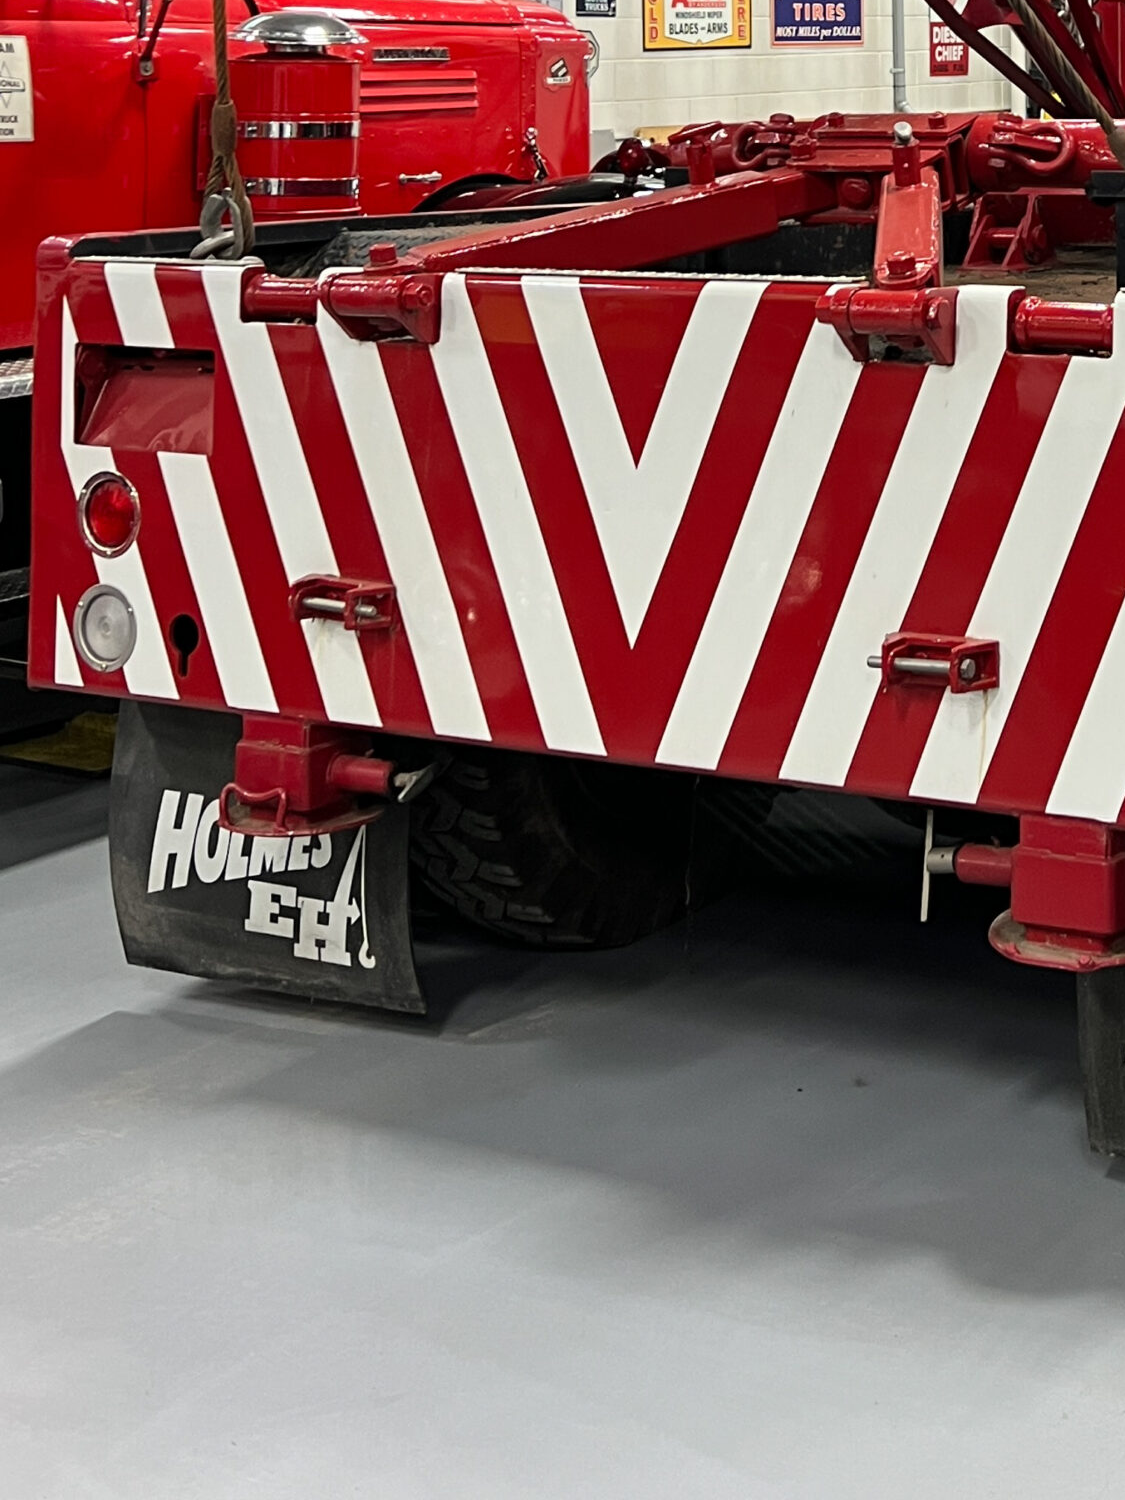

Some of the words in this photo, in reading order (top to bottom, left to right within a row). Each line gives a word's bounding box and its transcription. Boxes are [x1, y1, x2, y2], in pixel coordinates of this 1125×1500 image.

[584, 2, 609, 11] TRUCKS
[792, 2, 846, 21] TIRES
[675, 11, 706, 19] WINDSHIELD
[669, 22, 699, 35] BLADES
[707, 22, 728, 34] ARMS
[776, 26, 797, 37] MOST
[797, 26, 820, 36] MILES
[934, 44, 964, 62] CHIEF
[148, 789, 332, 893] HOLMES
